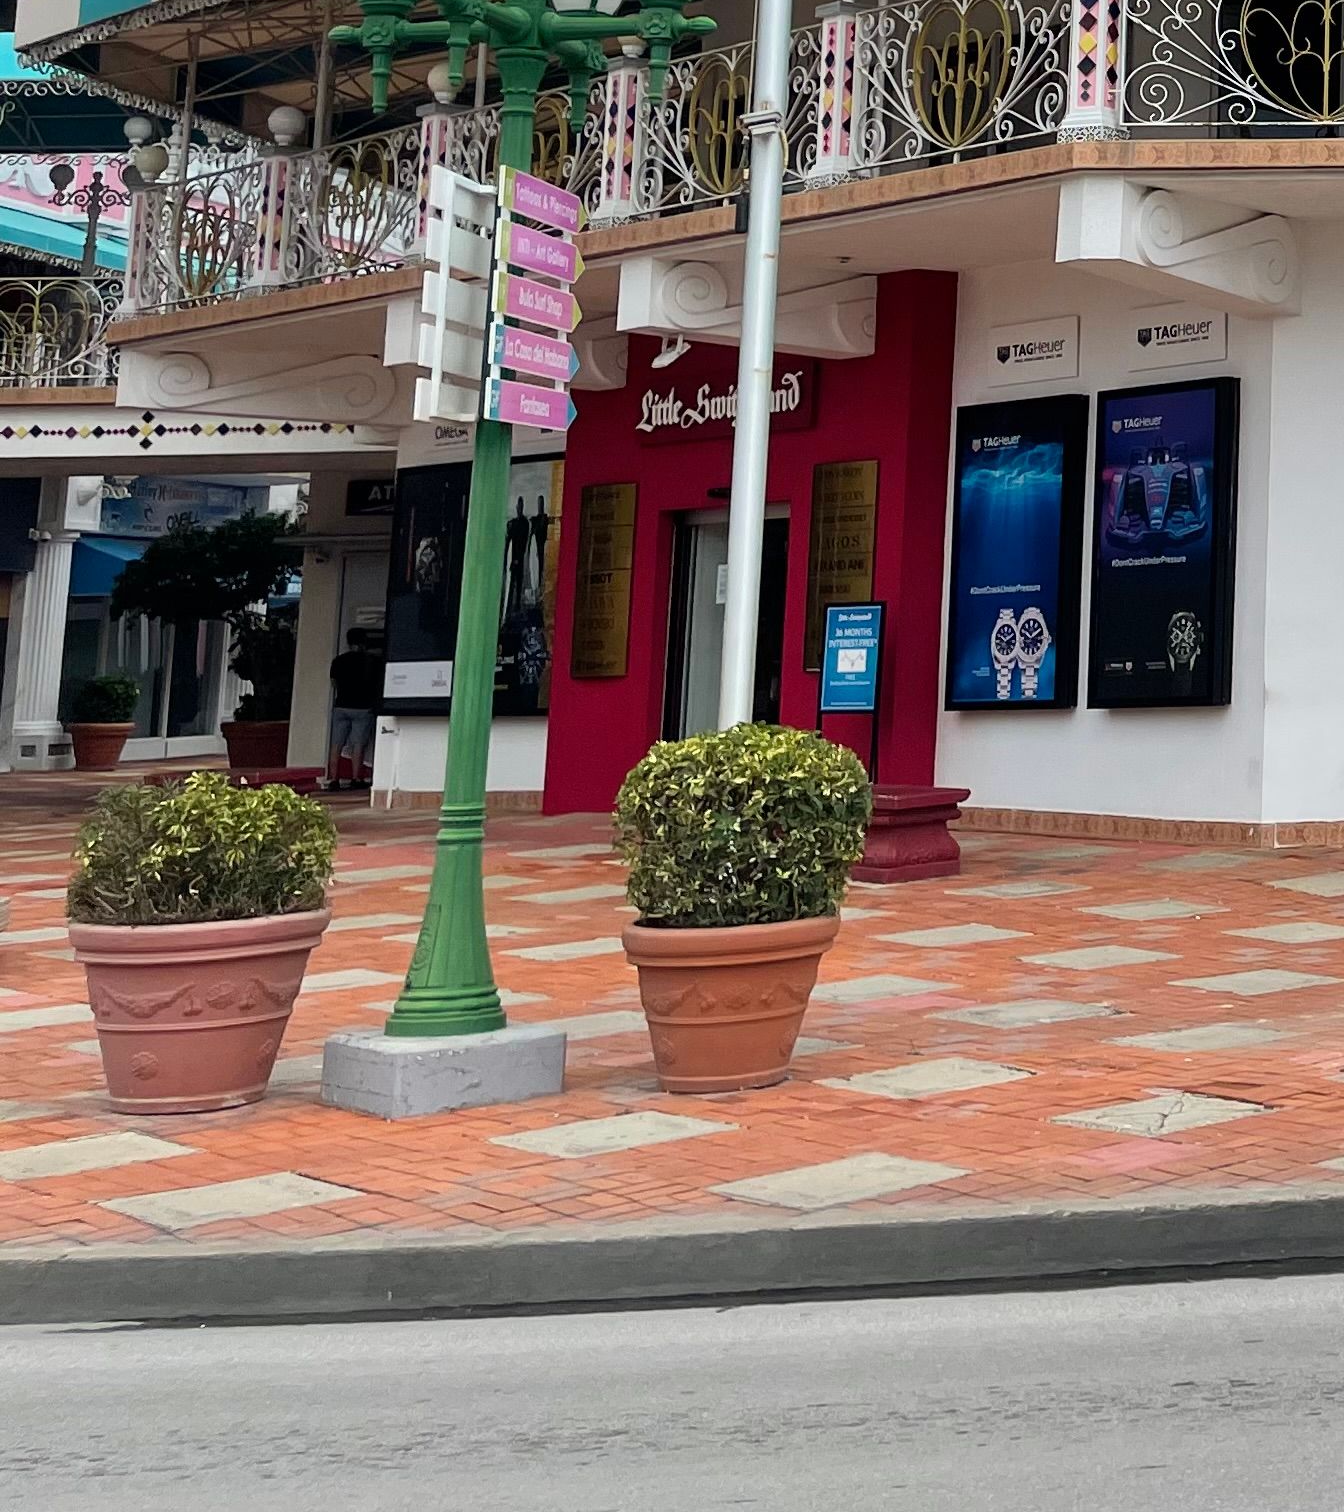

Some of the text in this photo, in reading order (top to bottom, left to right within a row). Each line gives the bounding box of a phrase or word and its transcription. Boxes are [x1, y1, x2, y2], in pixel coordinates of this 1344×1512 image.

[635, 387, 684, 432] Little
[368, 484, 394, 501] AT
[843, 627, 873, 637] MONTHS
